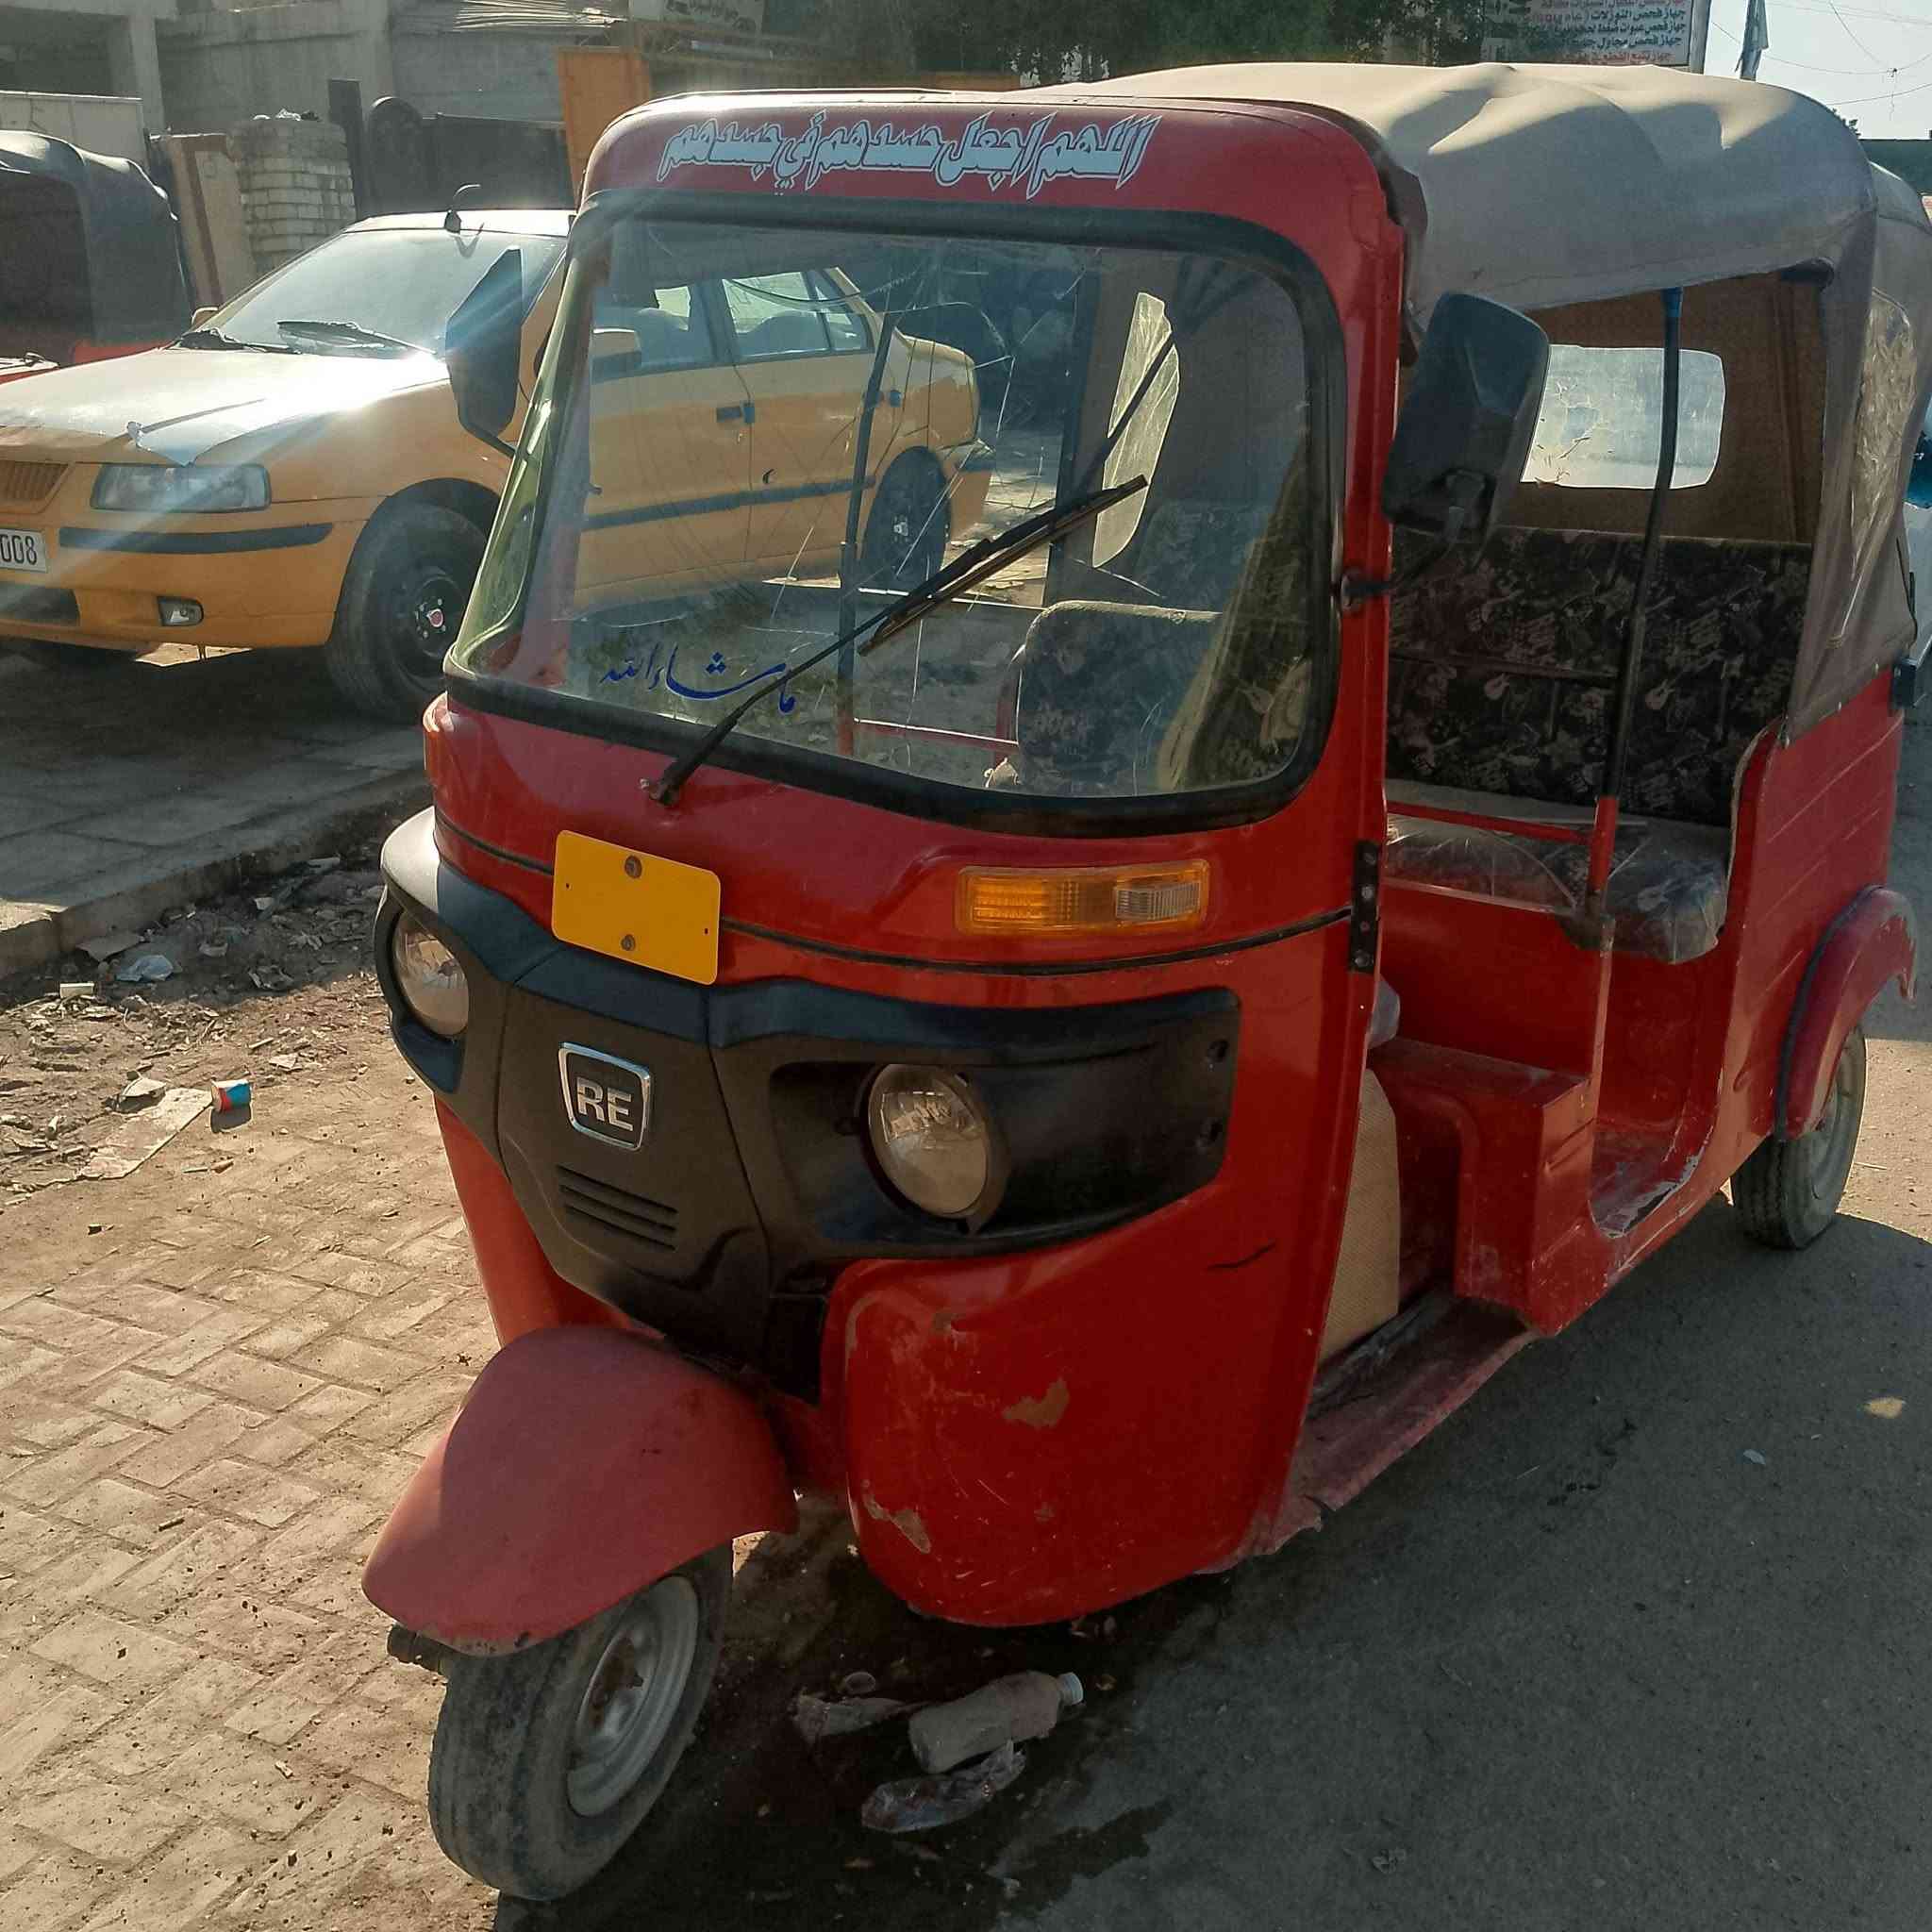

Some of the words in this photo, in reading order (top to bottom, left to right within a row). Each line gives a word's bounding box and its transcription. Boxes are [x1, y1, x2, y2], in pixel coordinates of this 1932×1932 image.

[657, 118, 783, 182] جسدهم
[773, 108, 826, 195] في
[805, 119, 944, 191] حسدهم
[935, 109, 1058, 192] اجعل
[1026, 113, 1162, 200] اللهم
[576, 1076, 633, 1131] RE
